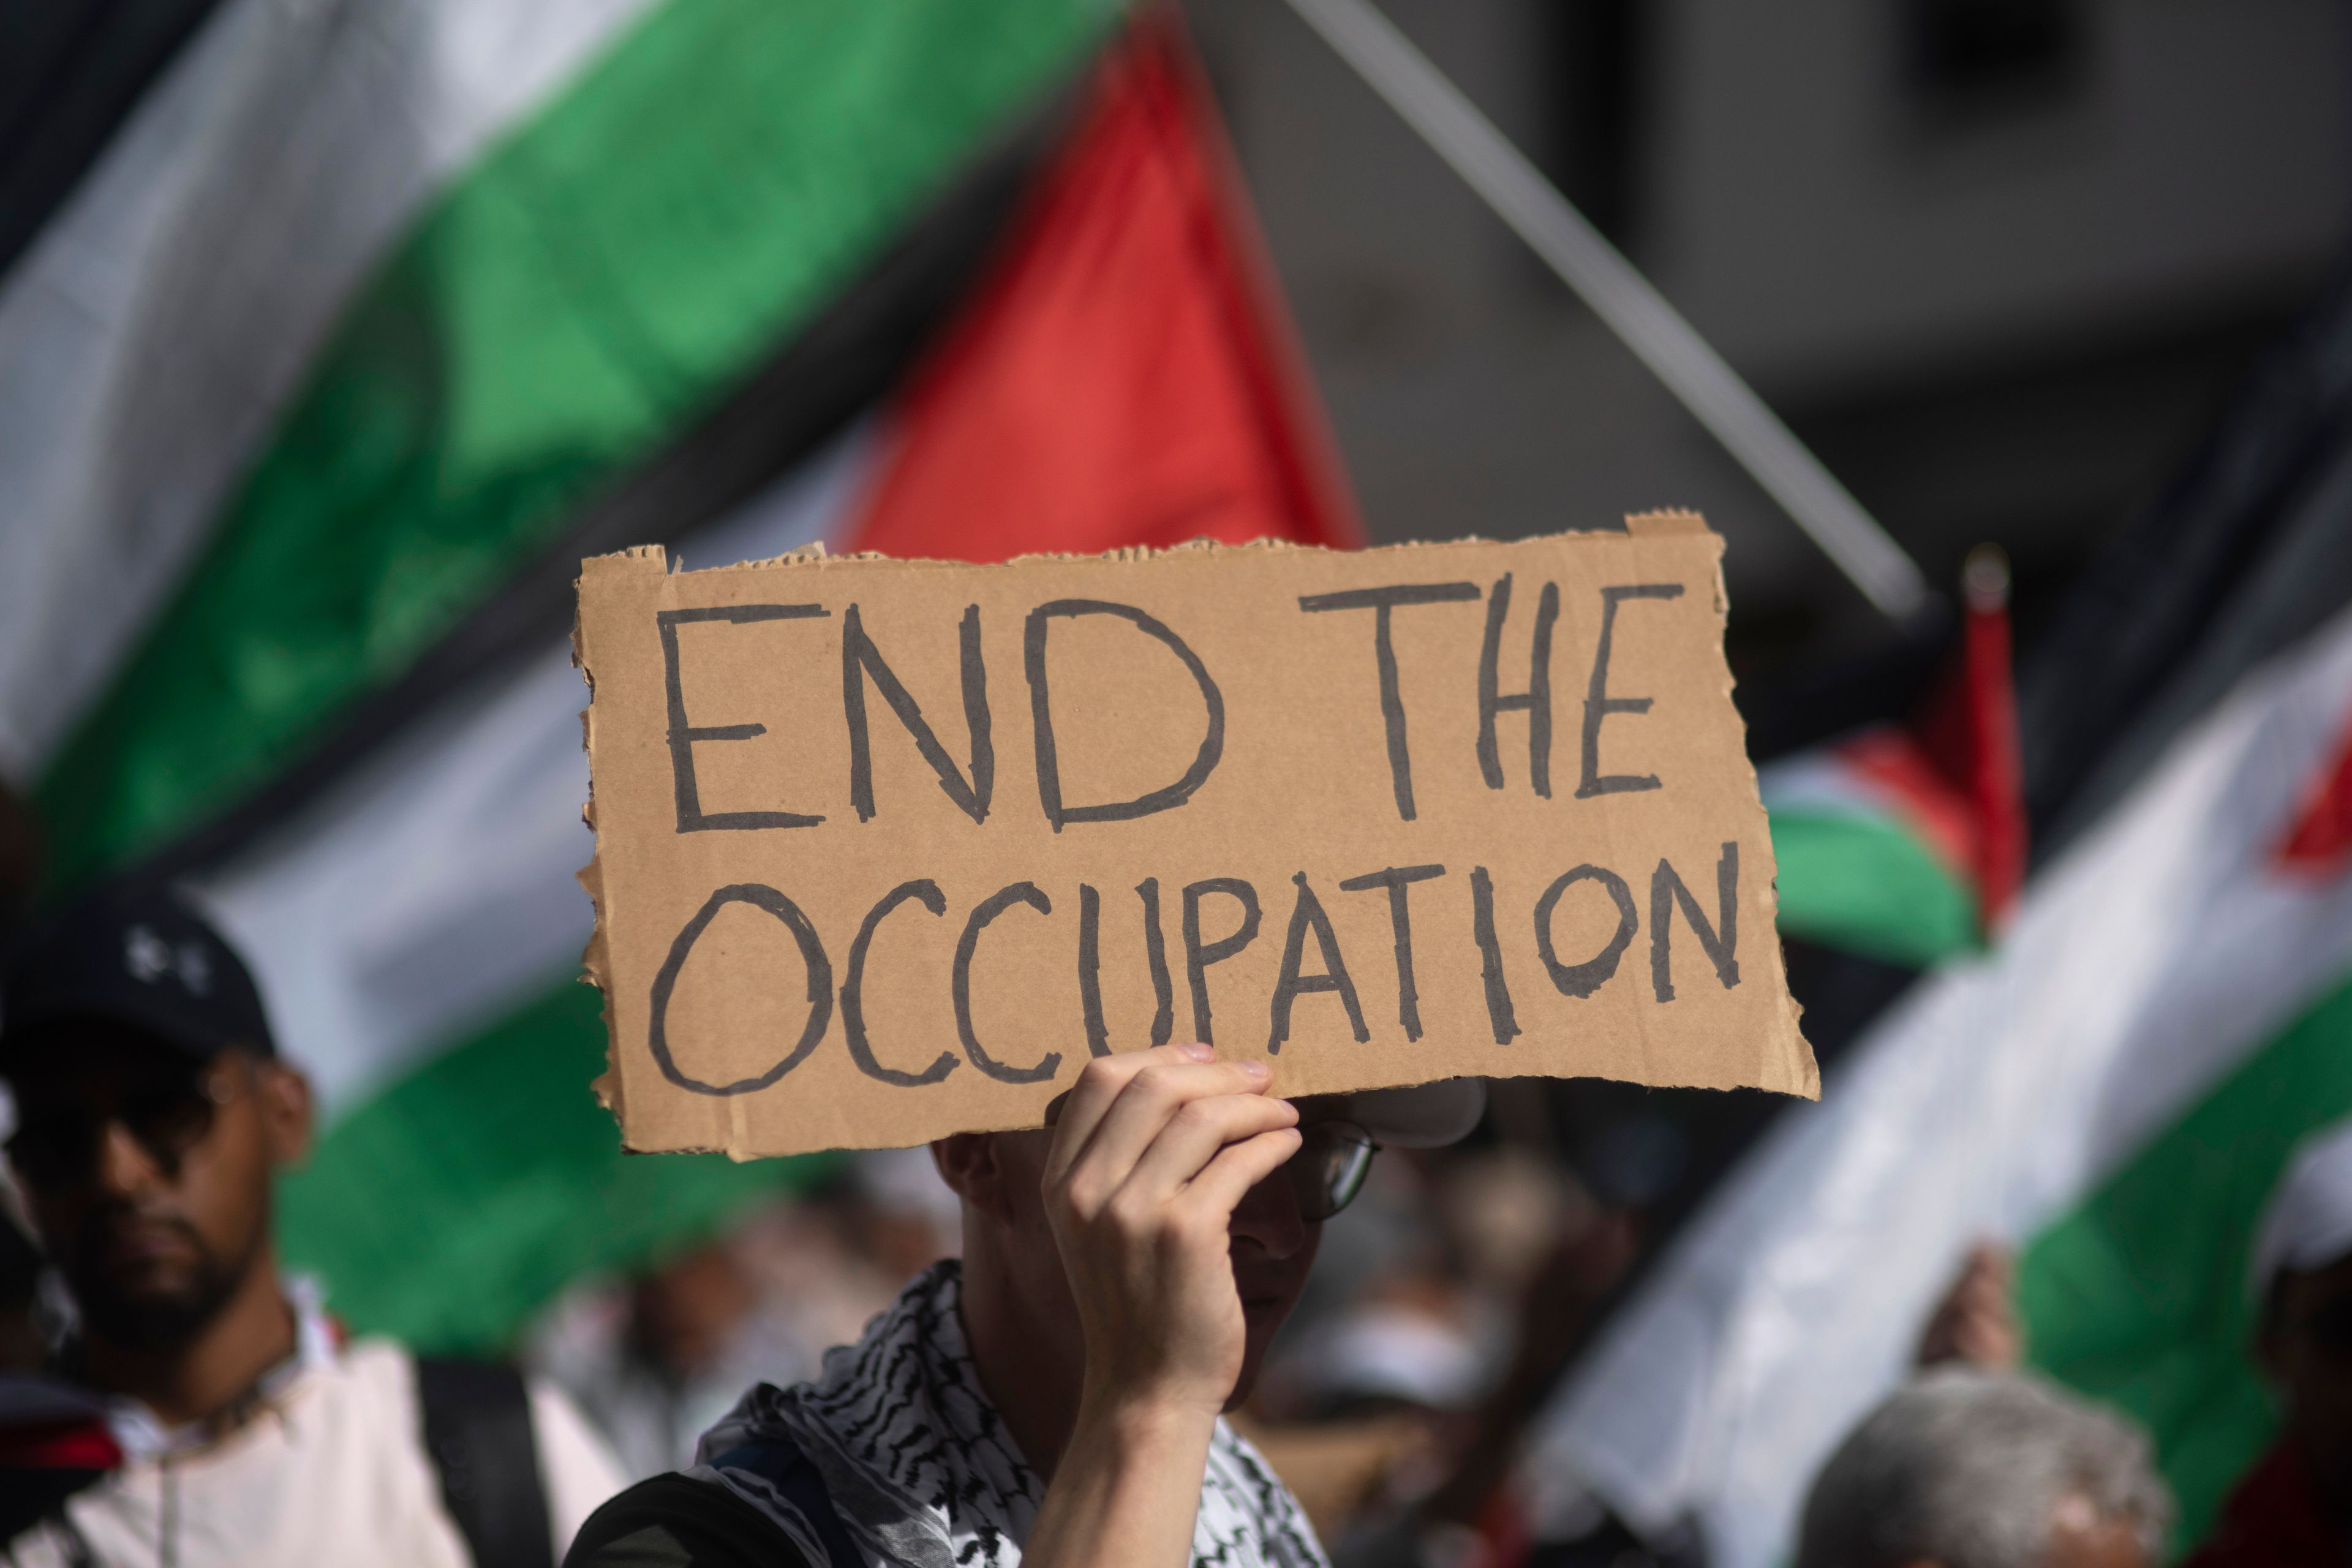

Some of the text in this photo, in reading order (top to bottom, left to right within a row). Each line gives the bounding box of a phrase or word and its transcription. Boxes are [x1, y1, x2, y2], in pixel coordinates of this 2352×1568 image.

[657, 573, 1684, 833] END THE
[648, 843, 1740, 1097] OCCUPATION
